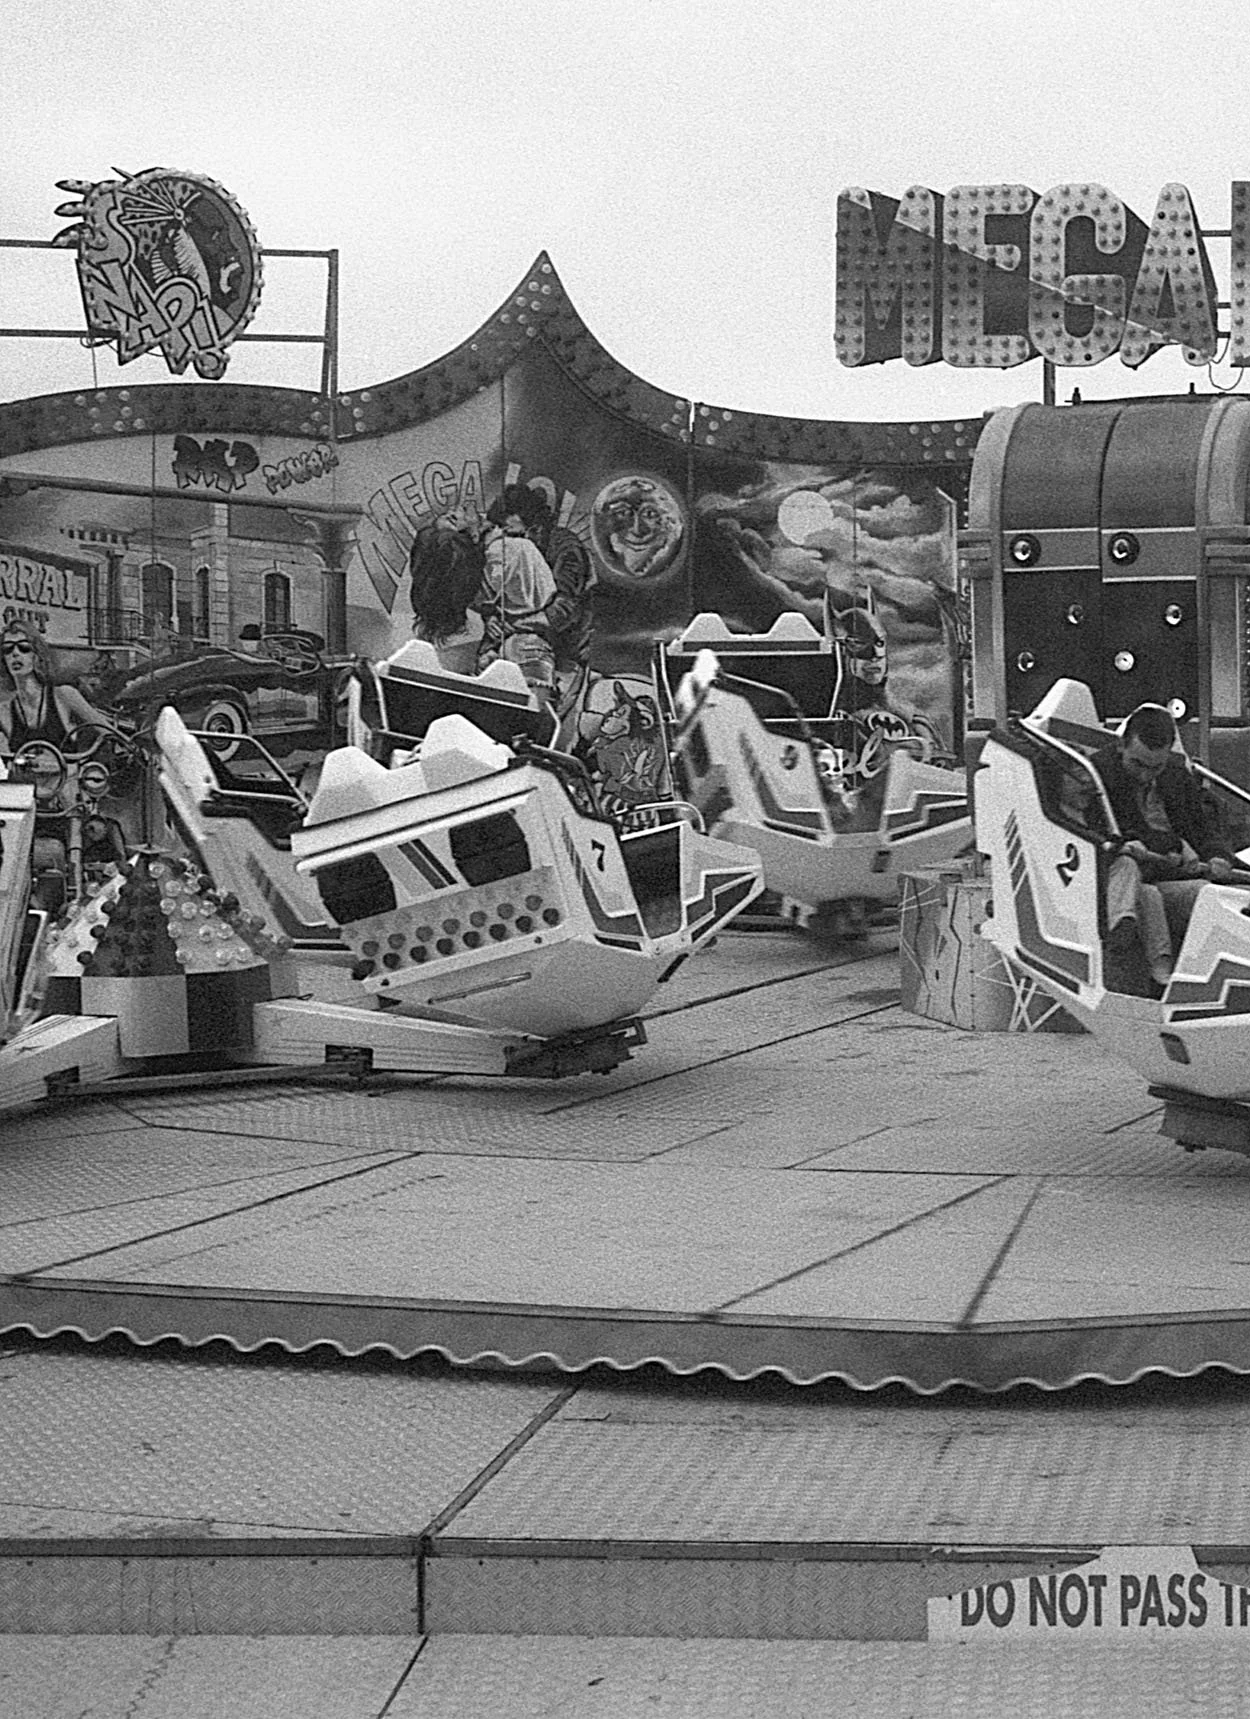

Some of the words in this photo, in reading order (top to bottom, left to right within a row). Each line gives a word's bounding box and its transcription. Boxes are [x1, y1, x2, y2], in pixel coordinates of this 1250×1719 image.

[75, 180, 228, 380] SNAP!
[835, 182, 1218, 368] MEGA
[353, 460, 487, 616] MEGA
[590, 838, 606, 872] 7
[1055, 842, 1080, 888] 2
[960, 1579, 1016, 1628] DO
[1029, 1572, 1107, 1628] NOT
[1120, 1572, 1208, 1628] PASS
